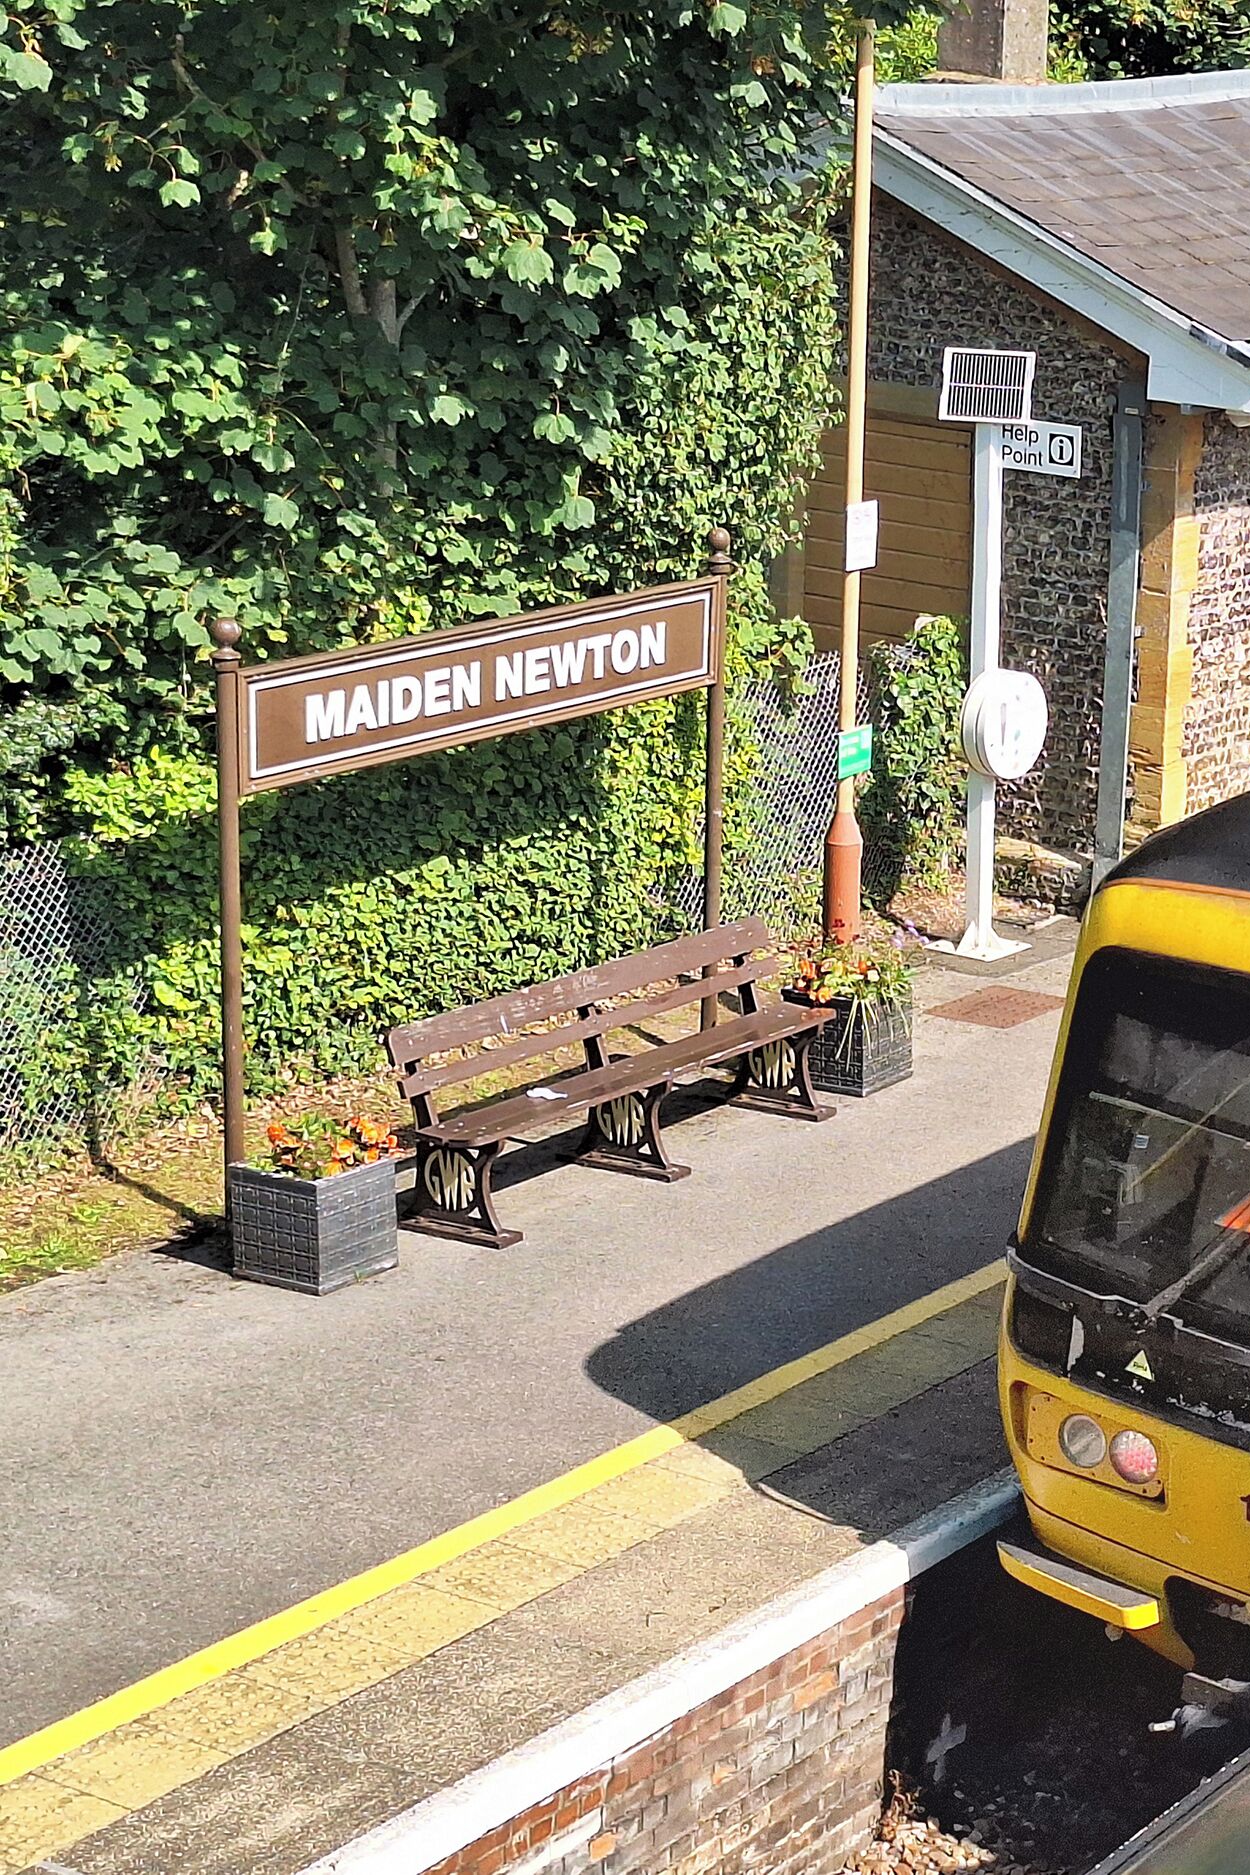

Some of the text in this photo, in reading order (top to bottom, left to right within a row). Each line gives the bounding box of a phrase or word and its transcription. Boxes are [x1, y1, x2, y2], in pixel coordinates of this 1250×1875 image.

[1002, 425, 1039, 446] Help
[1002, 445, 1043, 466] Point
[305, 621, 667, 744] MAIDEN NEWTON
[748, 1039, 796, 1088] GWR
[596, 1095, 645, 1147] GWR
[424, 1149, 476, 1211] GWR
